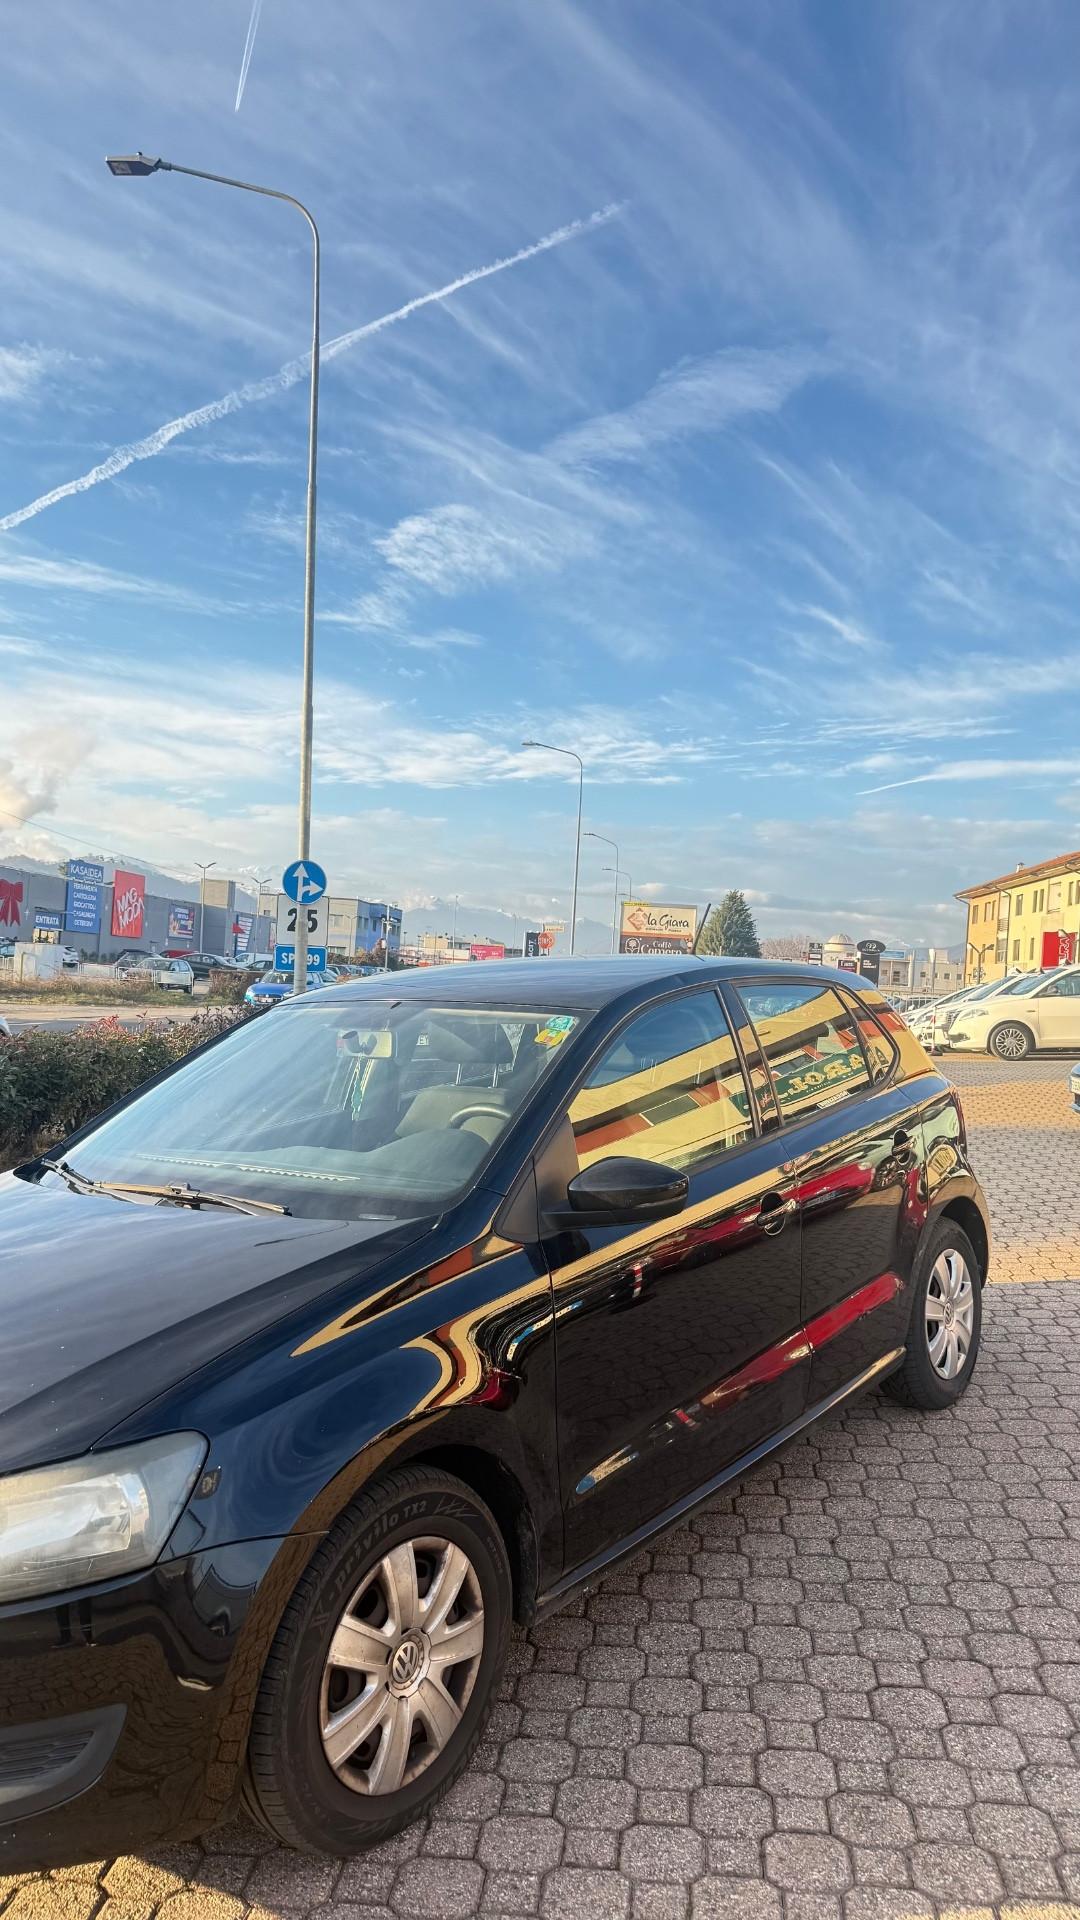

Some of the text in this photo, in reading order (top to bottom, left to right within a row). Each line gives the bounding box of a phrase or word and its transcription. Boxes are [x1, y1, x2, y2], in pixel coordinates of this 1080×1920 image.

[70, 863, 103, 878] KASAIDEA
[35, 915, 60, 925] ENTRATA
[647, 912, 689, 930] la Giara
[403, 1500, 427, 1518] TX2
